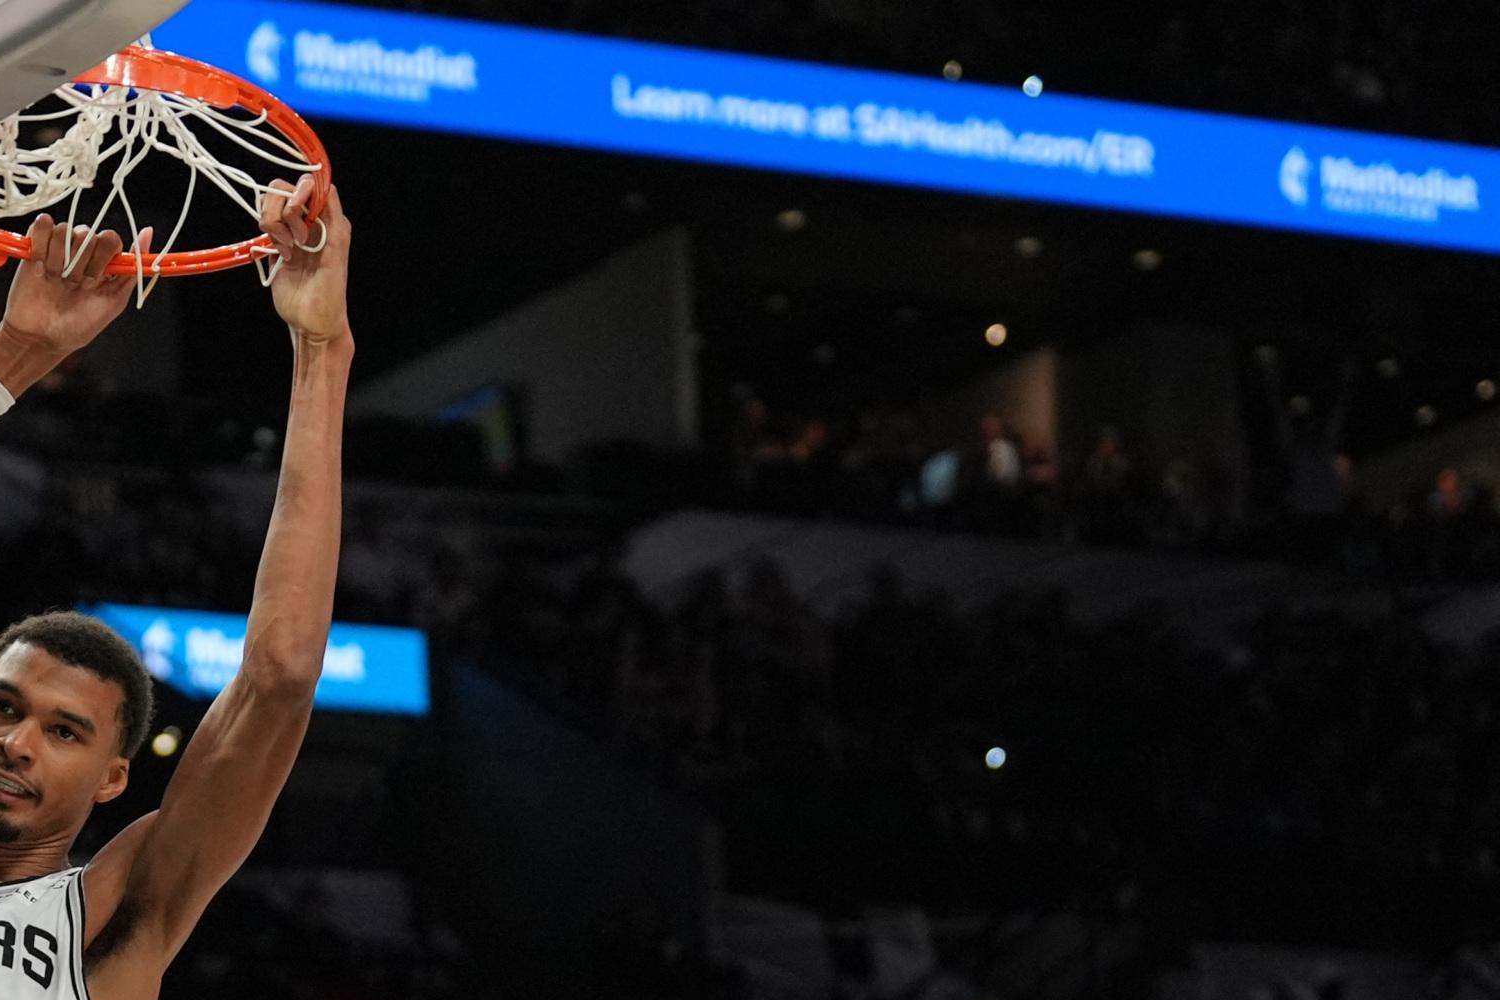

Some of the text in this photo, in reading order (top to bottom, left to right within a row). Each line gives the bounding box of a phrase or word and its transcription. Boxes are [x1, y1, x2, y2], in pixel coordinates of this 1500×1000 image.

[294, 30, 476, 89] Methodist
[611, 74, 713, 122] Learn
[715, 95, 810, 137] more
[812, 104, 850, 142] at
